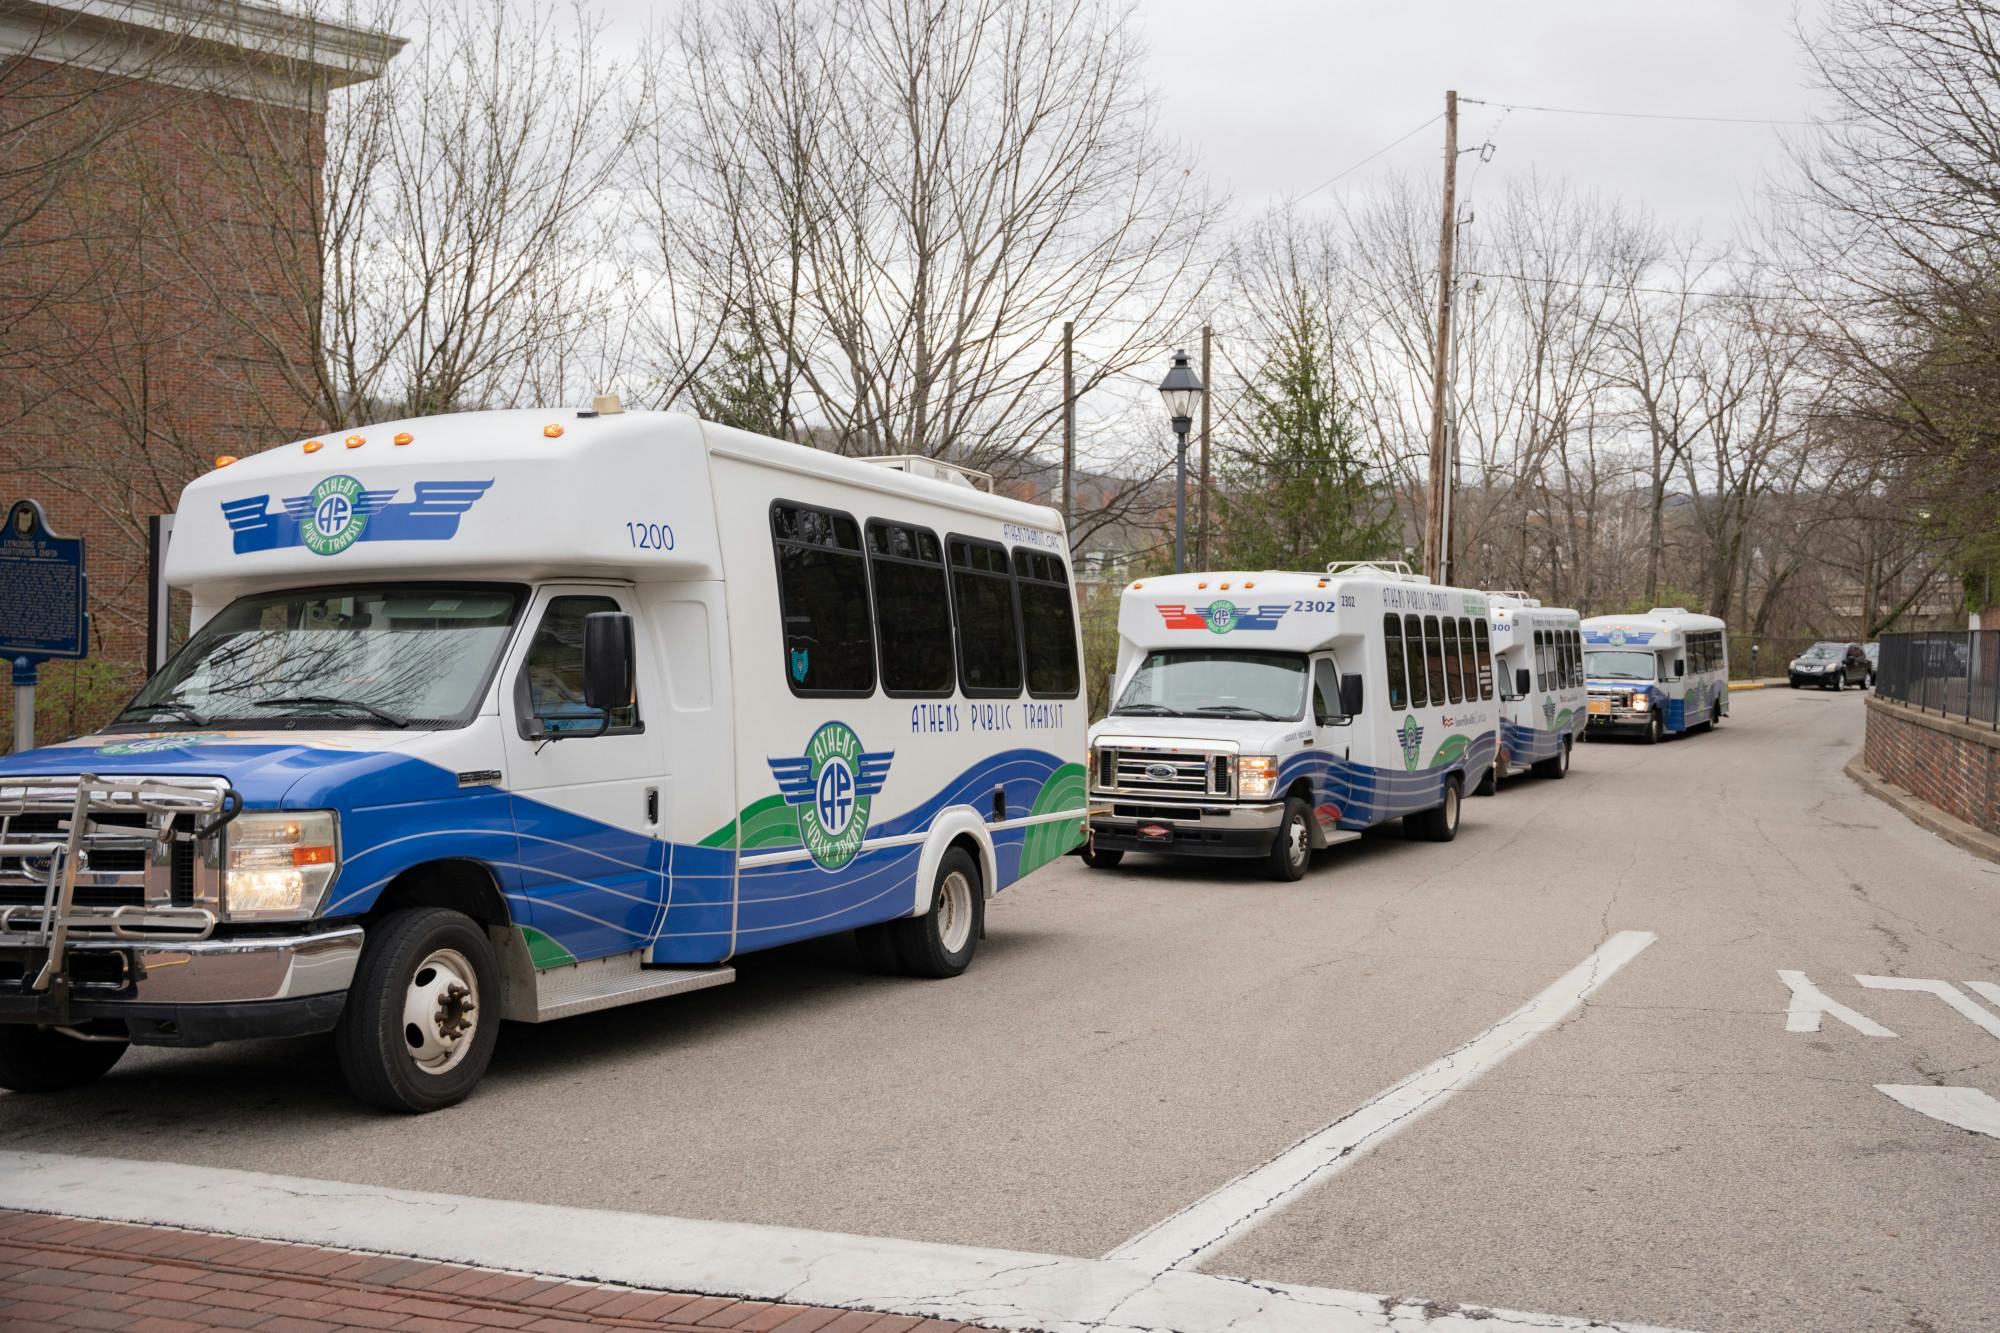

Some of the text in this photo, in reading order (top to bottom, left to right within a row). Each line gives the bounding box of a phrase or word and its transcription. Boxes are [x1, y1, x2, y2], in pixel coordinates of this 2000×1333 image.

[318, 478, 358, 499] ATHENS
[303, 519, 363, 552] PUBLIC TRANSIT
[626, 522, 674, 550] 1200
[1294, 600, 1336, 613] 2302
[1341, 595, 1355, 607] 2302
[1383, 587, 1405, 609] ATHENS
[911, 704, 1063, 733] ATHENS PUBLIC TRANSIT
[814, 727, 856, 764] ATHENS
[803, 804, 867, 863] PUBLIC TRANSIT
